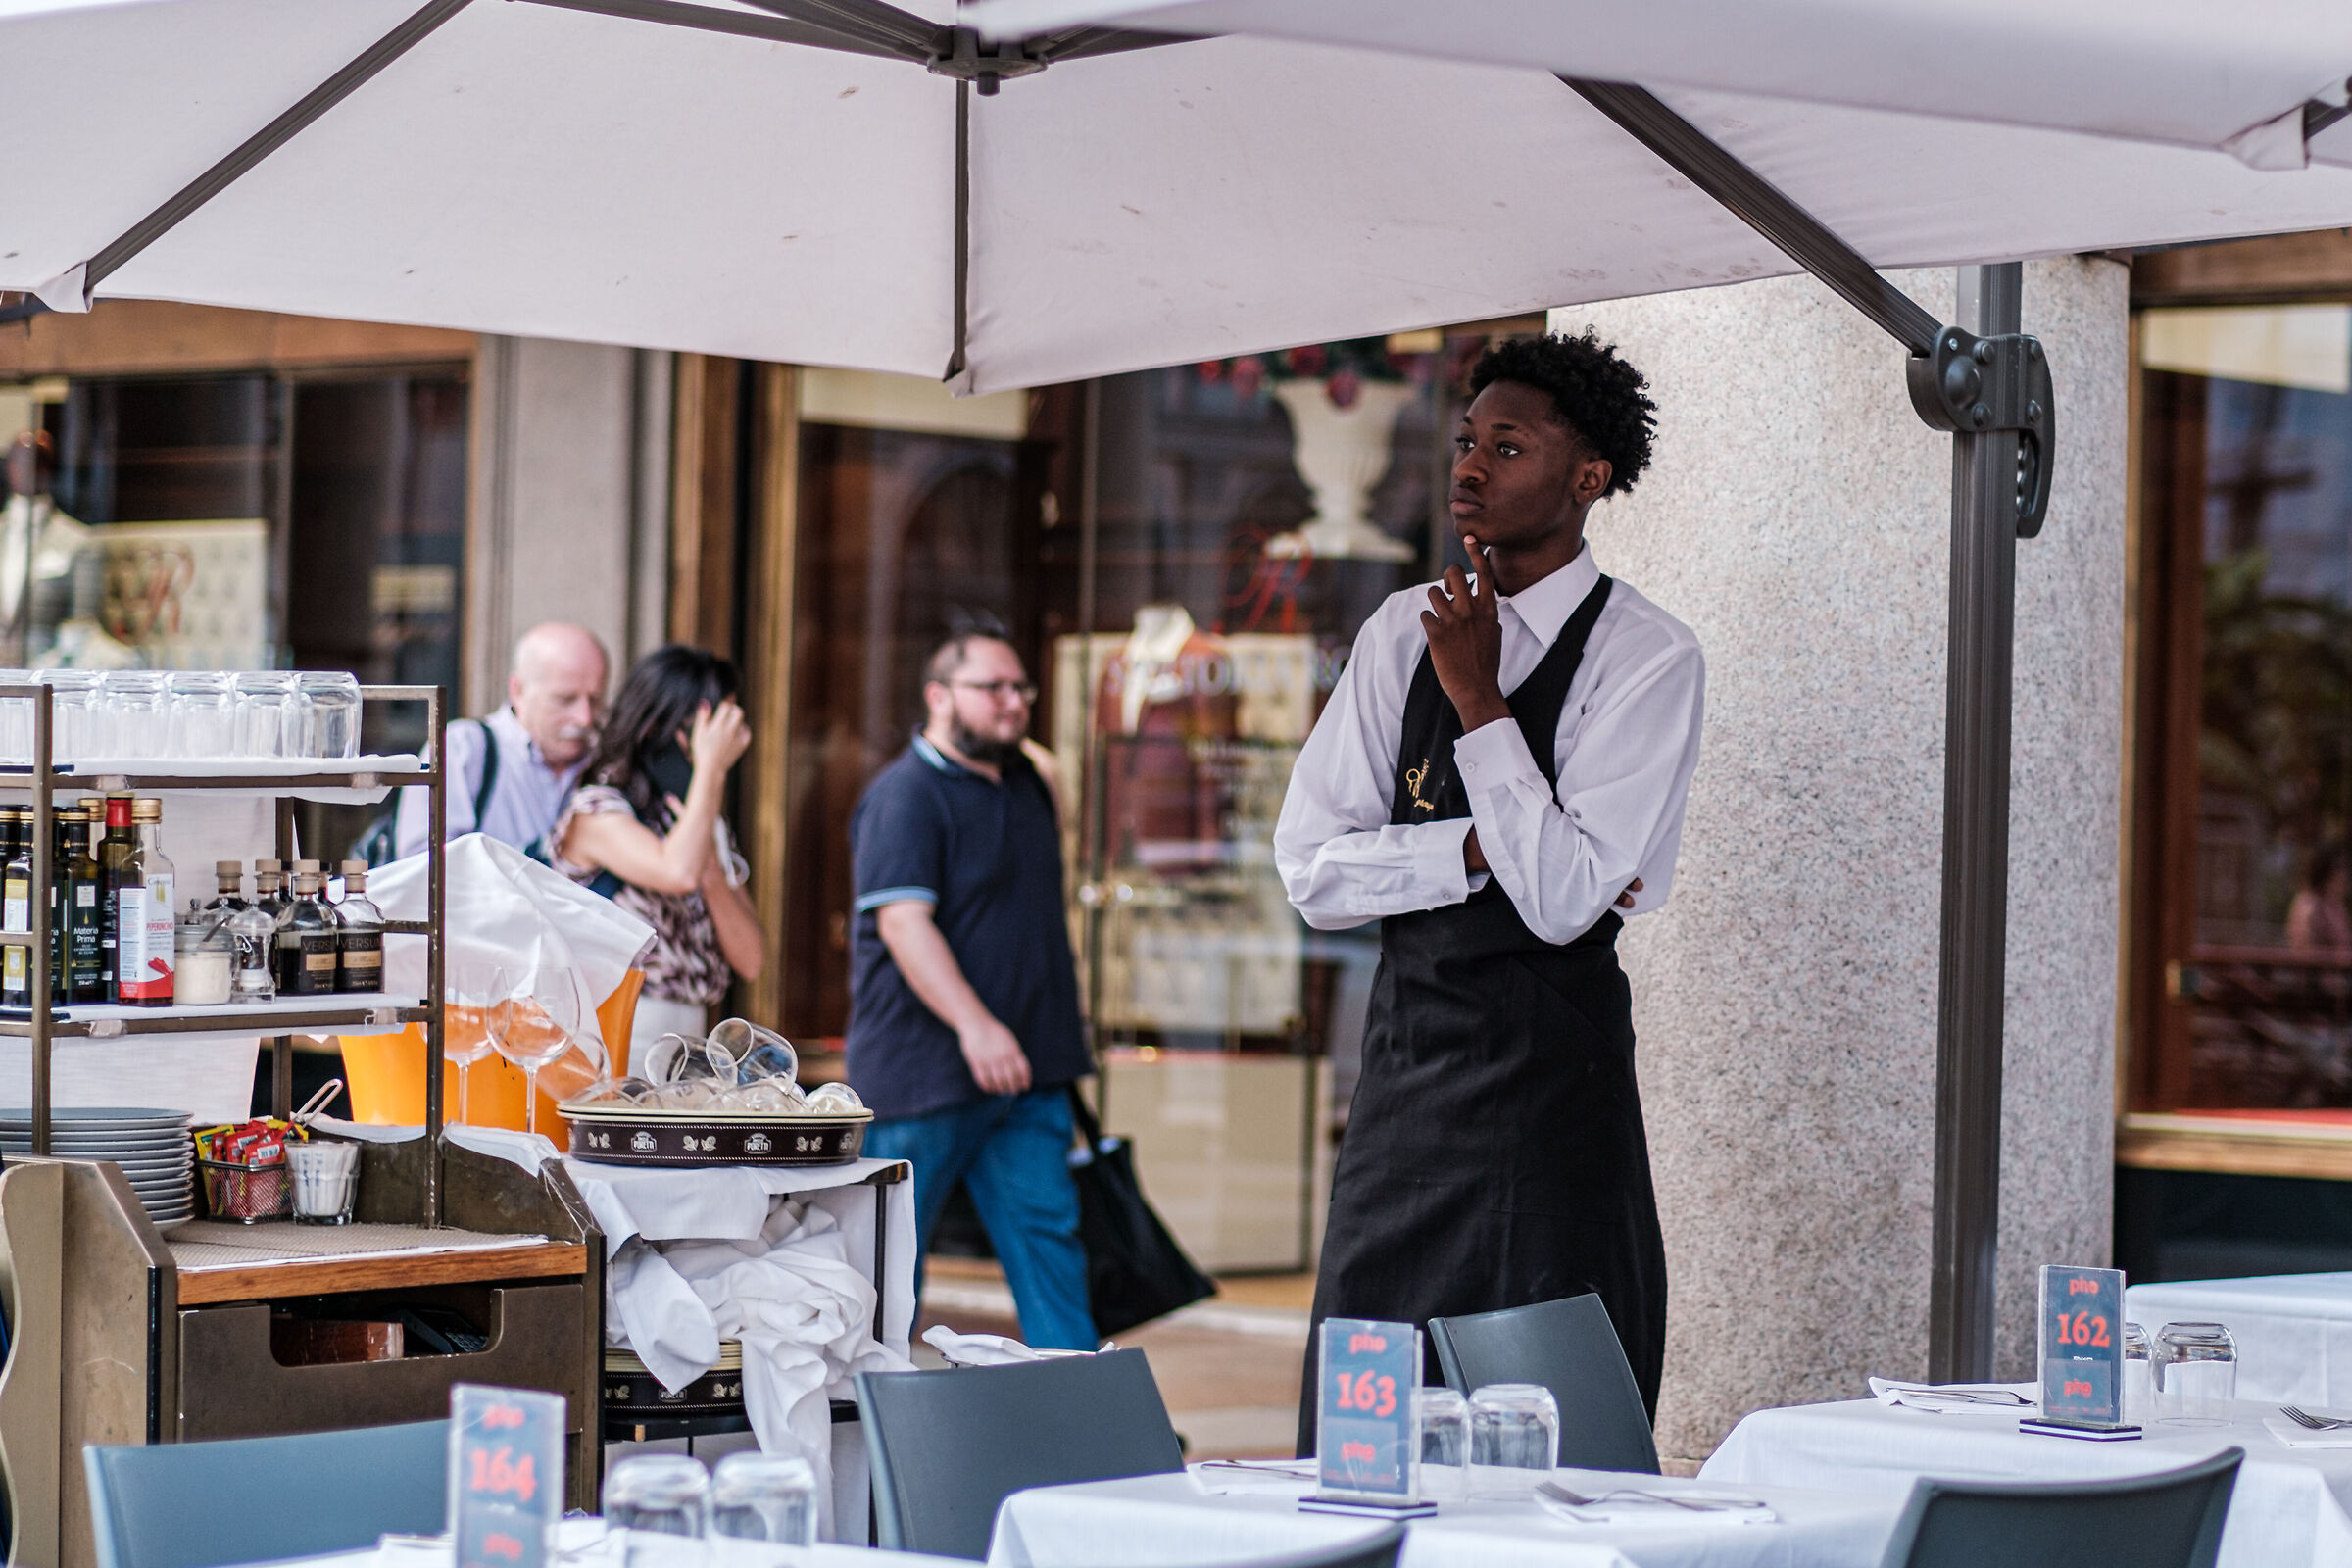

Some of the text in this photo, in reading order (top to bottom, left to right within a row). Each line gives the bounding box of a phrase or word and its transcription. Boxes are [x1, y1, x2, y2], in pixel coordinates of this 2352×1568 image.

[74, 926, 99, 935] Materia
[77, 935, 96, 944] Prima
[2069, 1276, 2099, 1296] pho
[2057, 1310, 2110, 1348] 162
[1337, 1369, 1396, 1417] 163
[2064, 1379, 2093, 1397] pho
[470, 1446, 537, 1502] 164
